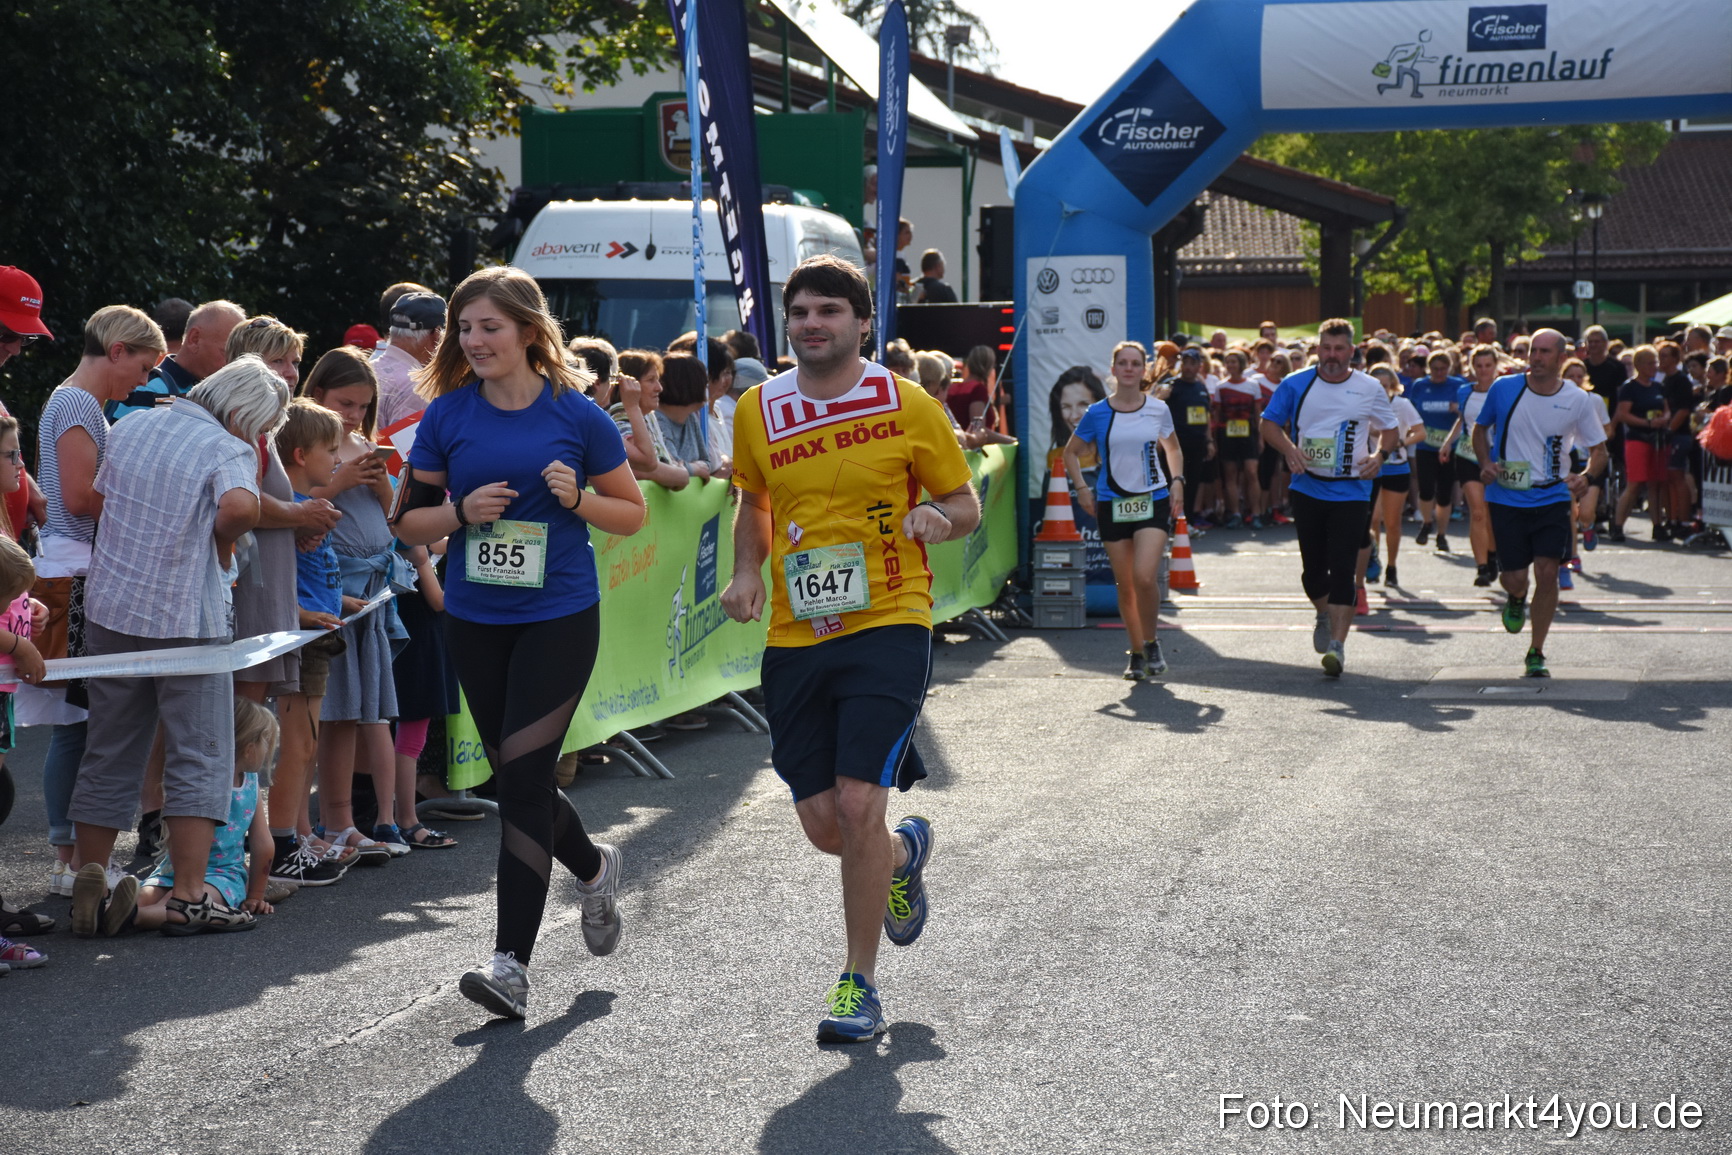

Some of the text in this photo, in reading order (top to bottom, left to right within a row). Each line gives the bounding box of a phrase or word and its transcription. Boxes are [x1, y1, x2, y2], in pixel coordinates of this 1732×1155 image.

[1483, 22, 1542, 35] Fischer
[1489, 34, 1537, 42] AUTOMOBILE
[1438, 48, 1614, 85] firmenlauf
[1438, 85, 1509, 97] neumarkt
[1115, 121, 1204, 140] Fischer
[1123, 141, 1196, 150] AUTOMOBILE
[531, 242, 602, 257] abavent
[1036, 327, 1066, 335] SEAT
[769, 420, 905, 470] MAX BÖGL
[1342, 419, 1360, 476] HUBER
[1117, 501, 1148, 514] 1036
[478, 542, 525, 568] 855
[477, 565, 526, 576] Fürst Franziska
[843, 560, 860, 568] 2019
[794, 568, 854, 600] 1647
[804, 598, 824, 607] Piehler
[685, 582, 730, 653] firmenla
